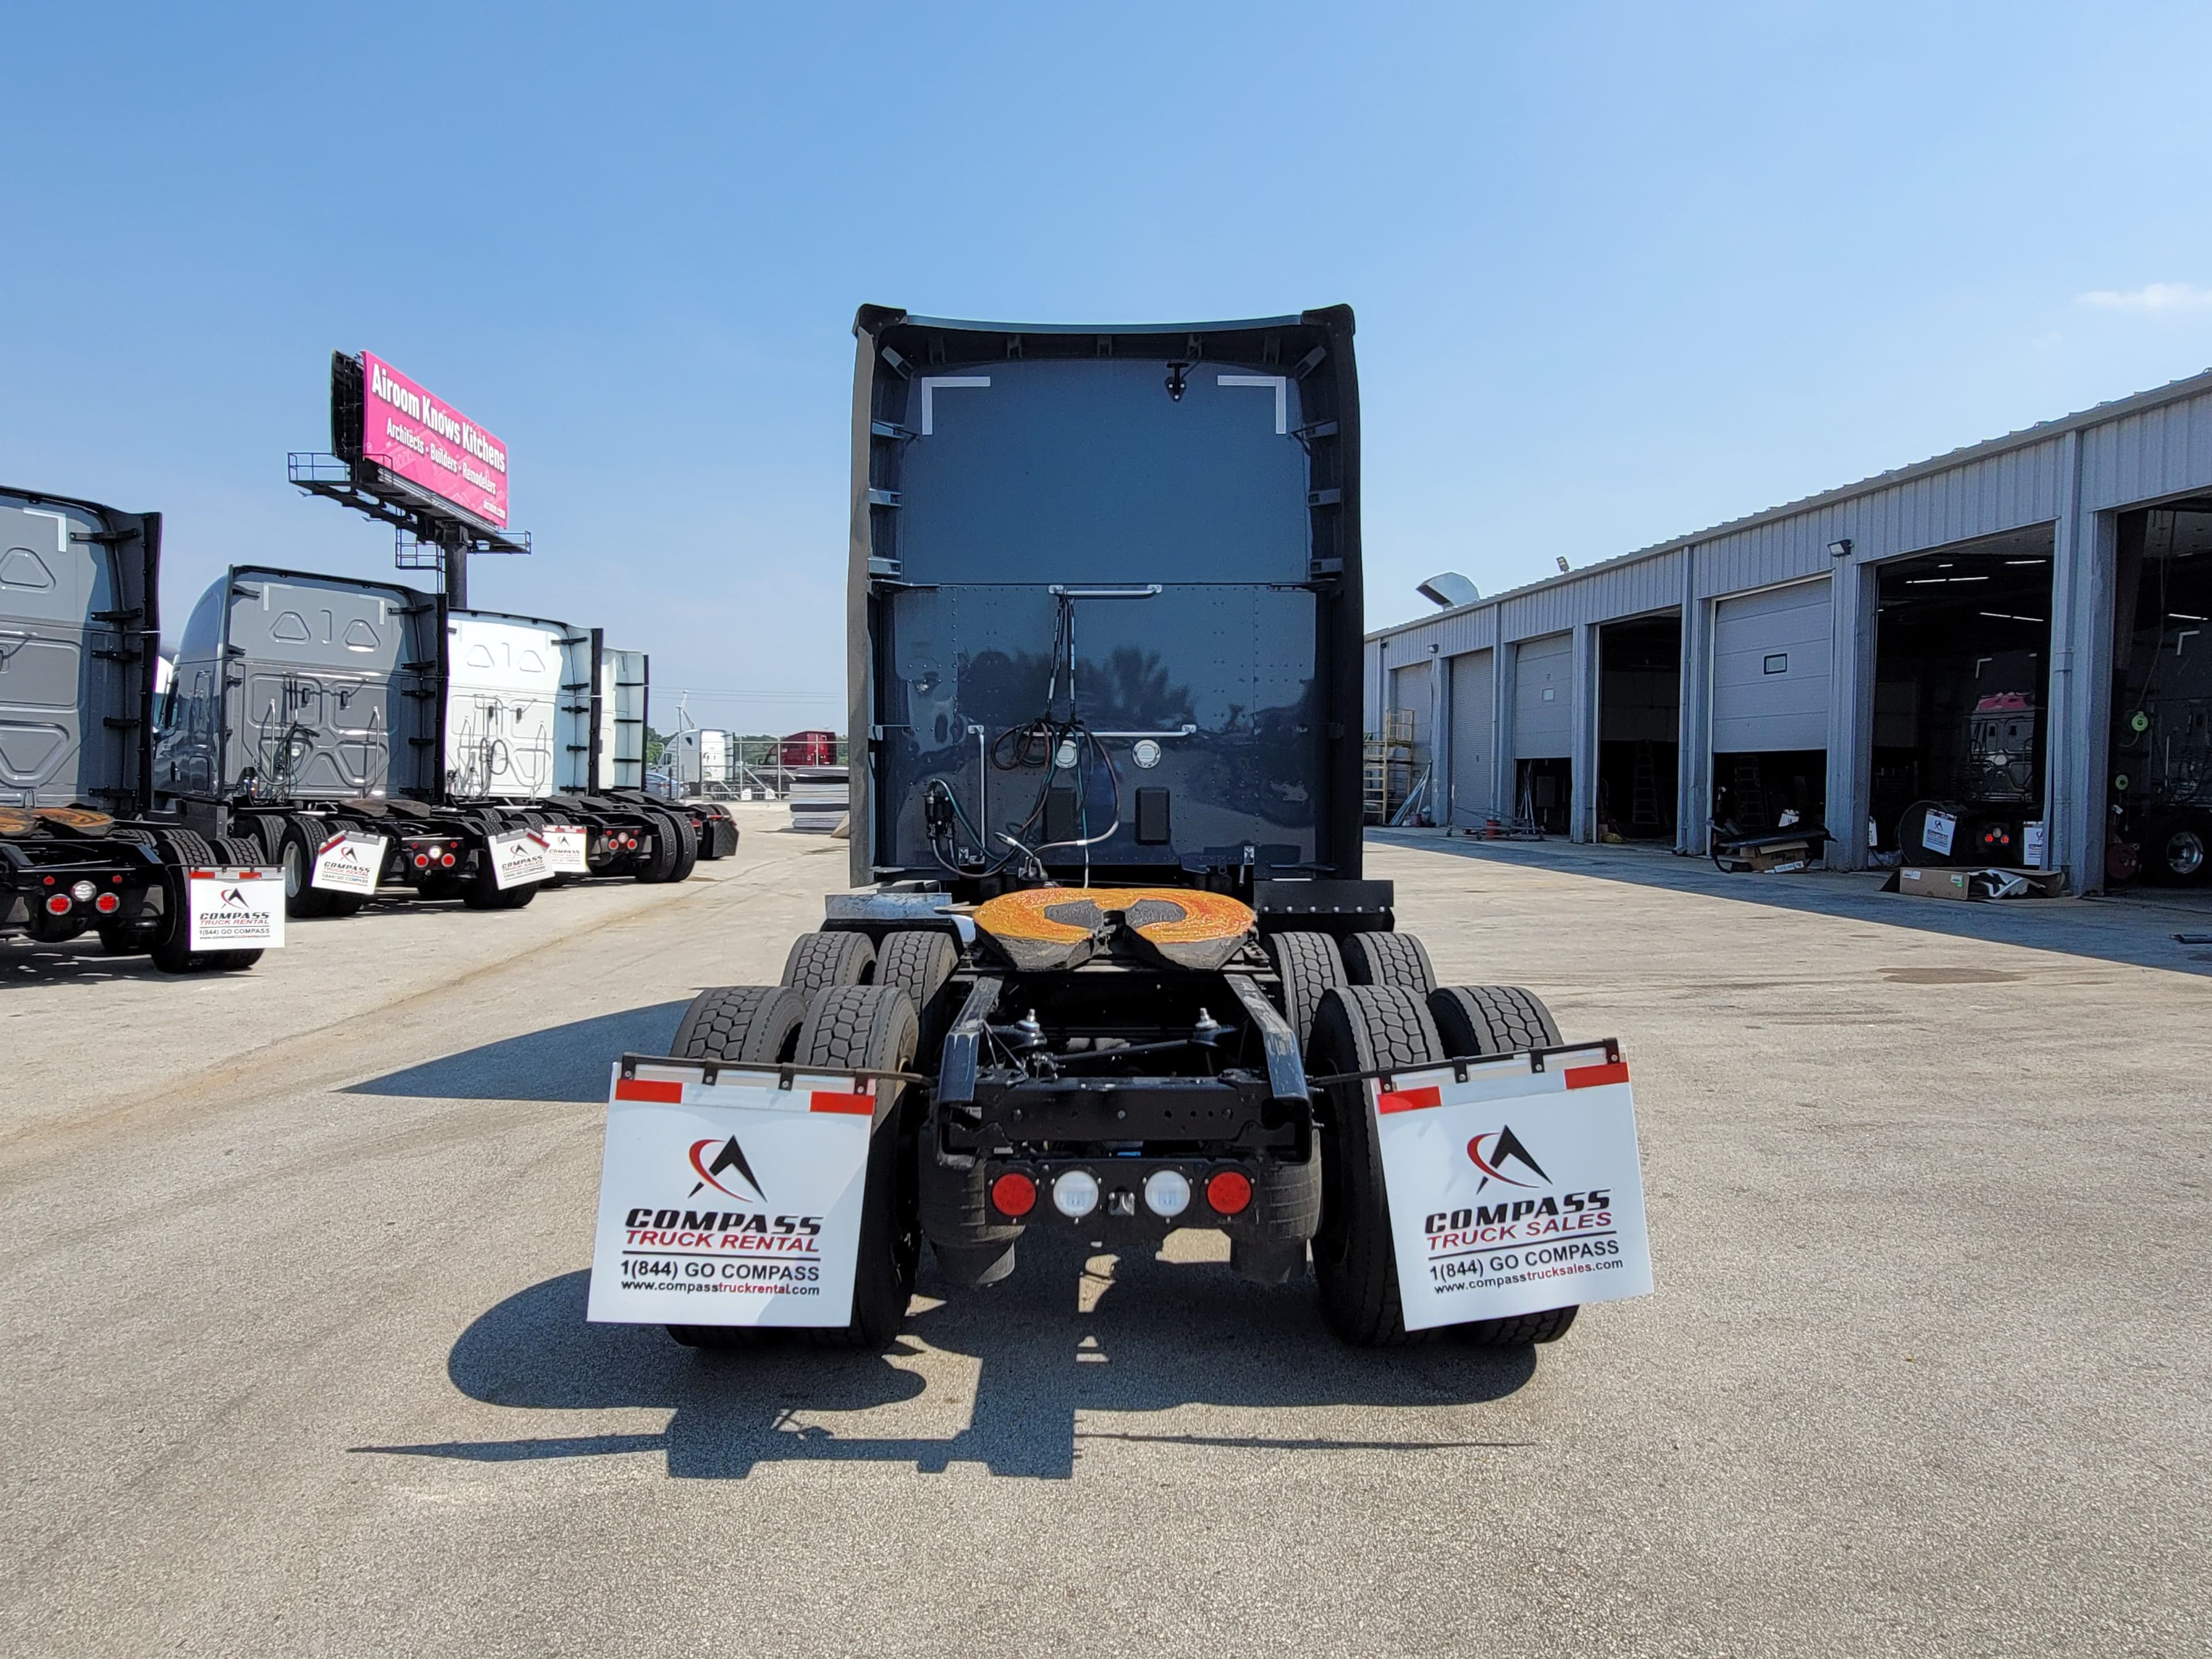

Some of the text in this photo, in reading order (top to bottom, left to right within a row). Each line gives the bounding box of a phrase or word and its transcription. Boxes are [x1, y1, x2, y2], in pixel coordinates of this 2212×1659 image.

[372, 363, 506, 472] Airoom Knows Kitchens
[387, 417, 425, 454] Architects
[430, 442, 458, 473] Builders
[324, 861, 372, 872] COMPASS
[502, 855, 543, 869] COMPASS
[200, 912, 270, 920] COMPASS
[625, 1208, 824, 1236] COMPASS
[1425, 1189, 1611, 1234] COMPASS
[626, 1230, 820, 1252] TRUCK RENTAL
[1427, 1212, 1612, 1251] TRUCK SALES
[621, 1259, 820, 1281] 1(844) GO COMPASS
[1430, 1240, 1619, 1283] 1(844) GO COMPASS
[622, 1281, 820, 1296] www.compasstruckrental.com
[1434, 1259, 1623, 1294] www.compasstrucksales.com
